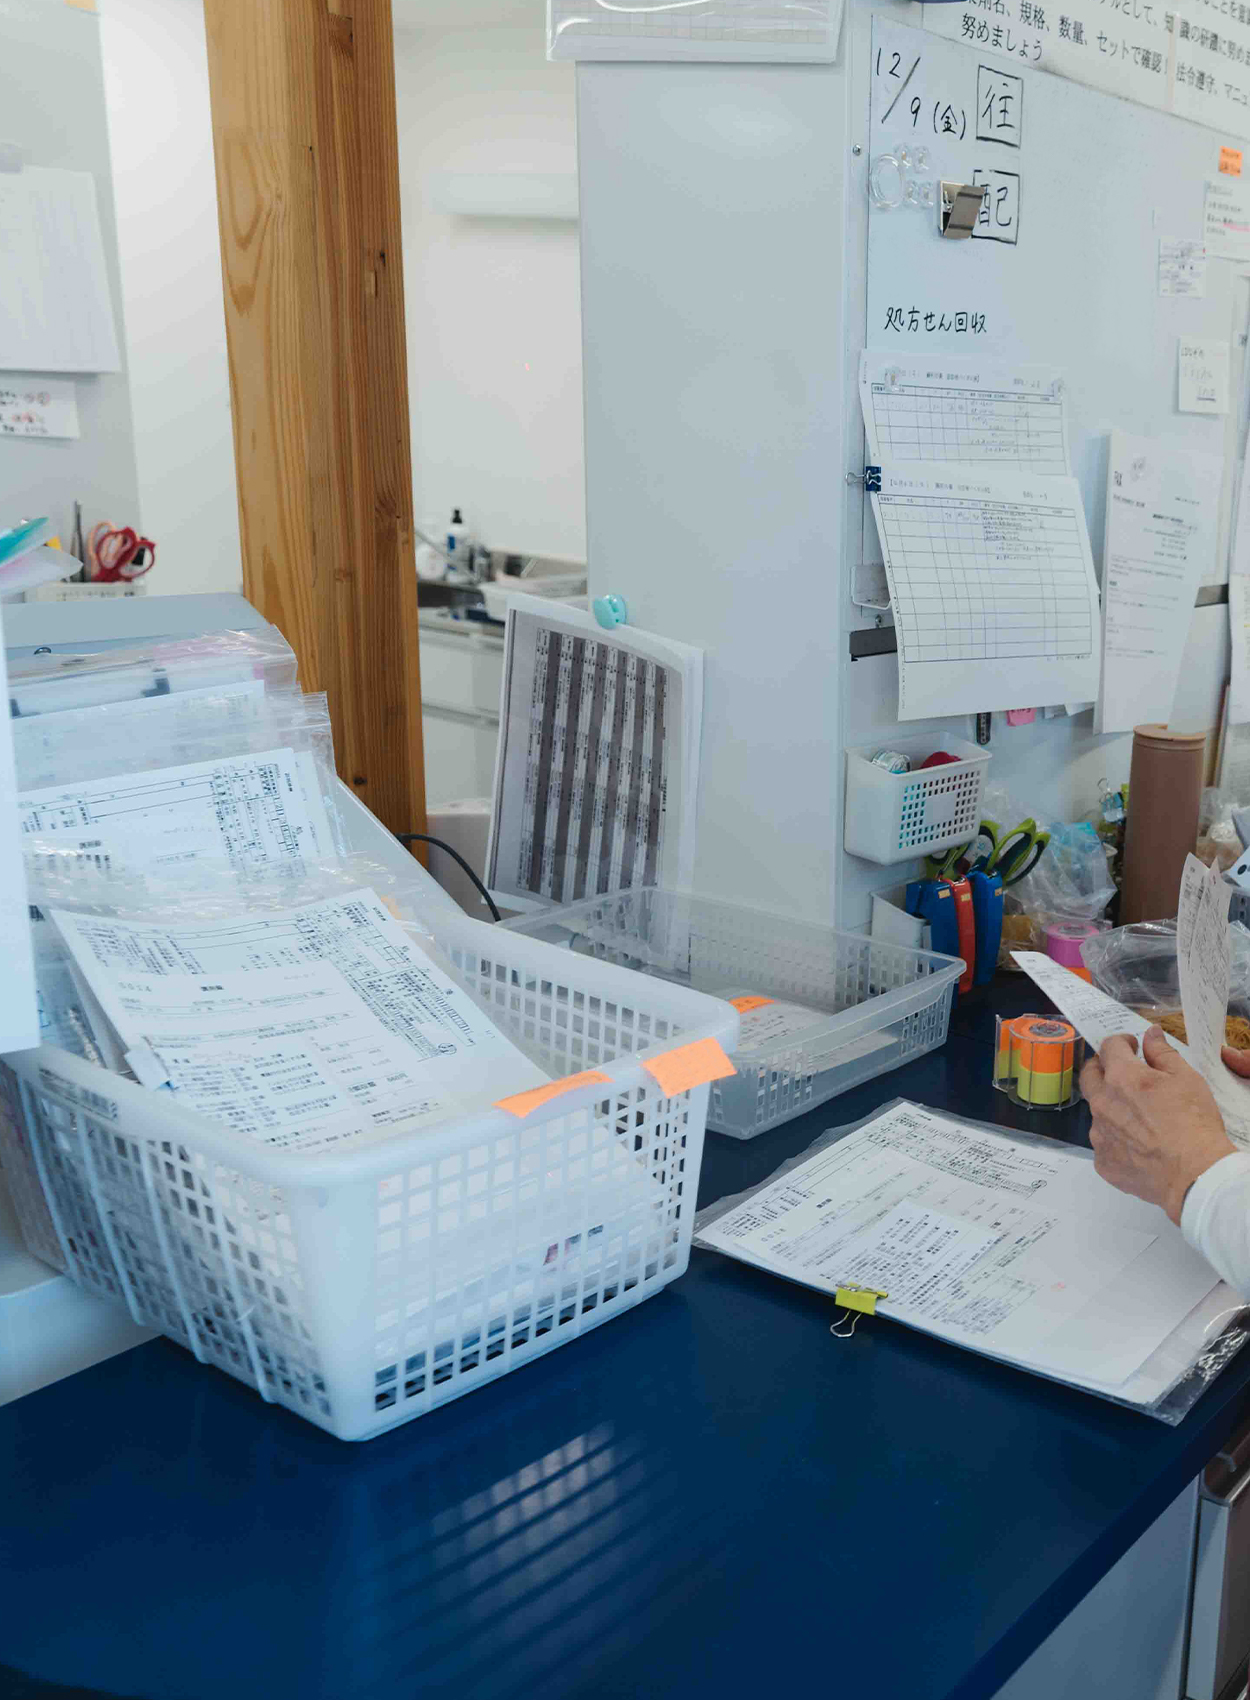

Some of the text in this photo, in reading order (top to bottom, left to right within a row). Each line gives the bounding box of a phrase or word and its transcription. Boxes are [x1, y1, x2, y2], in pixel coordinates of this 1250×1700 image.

[961, 13, 1043, 61] 努めましょう
[884, 306, 987, 333] 処方せん回収
